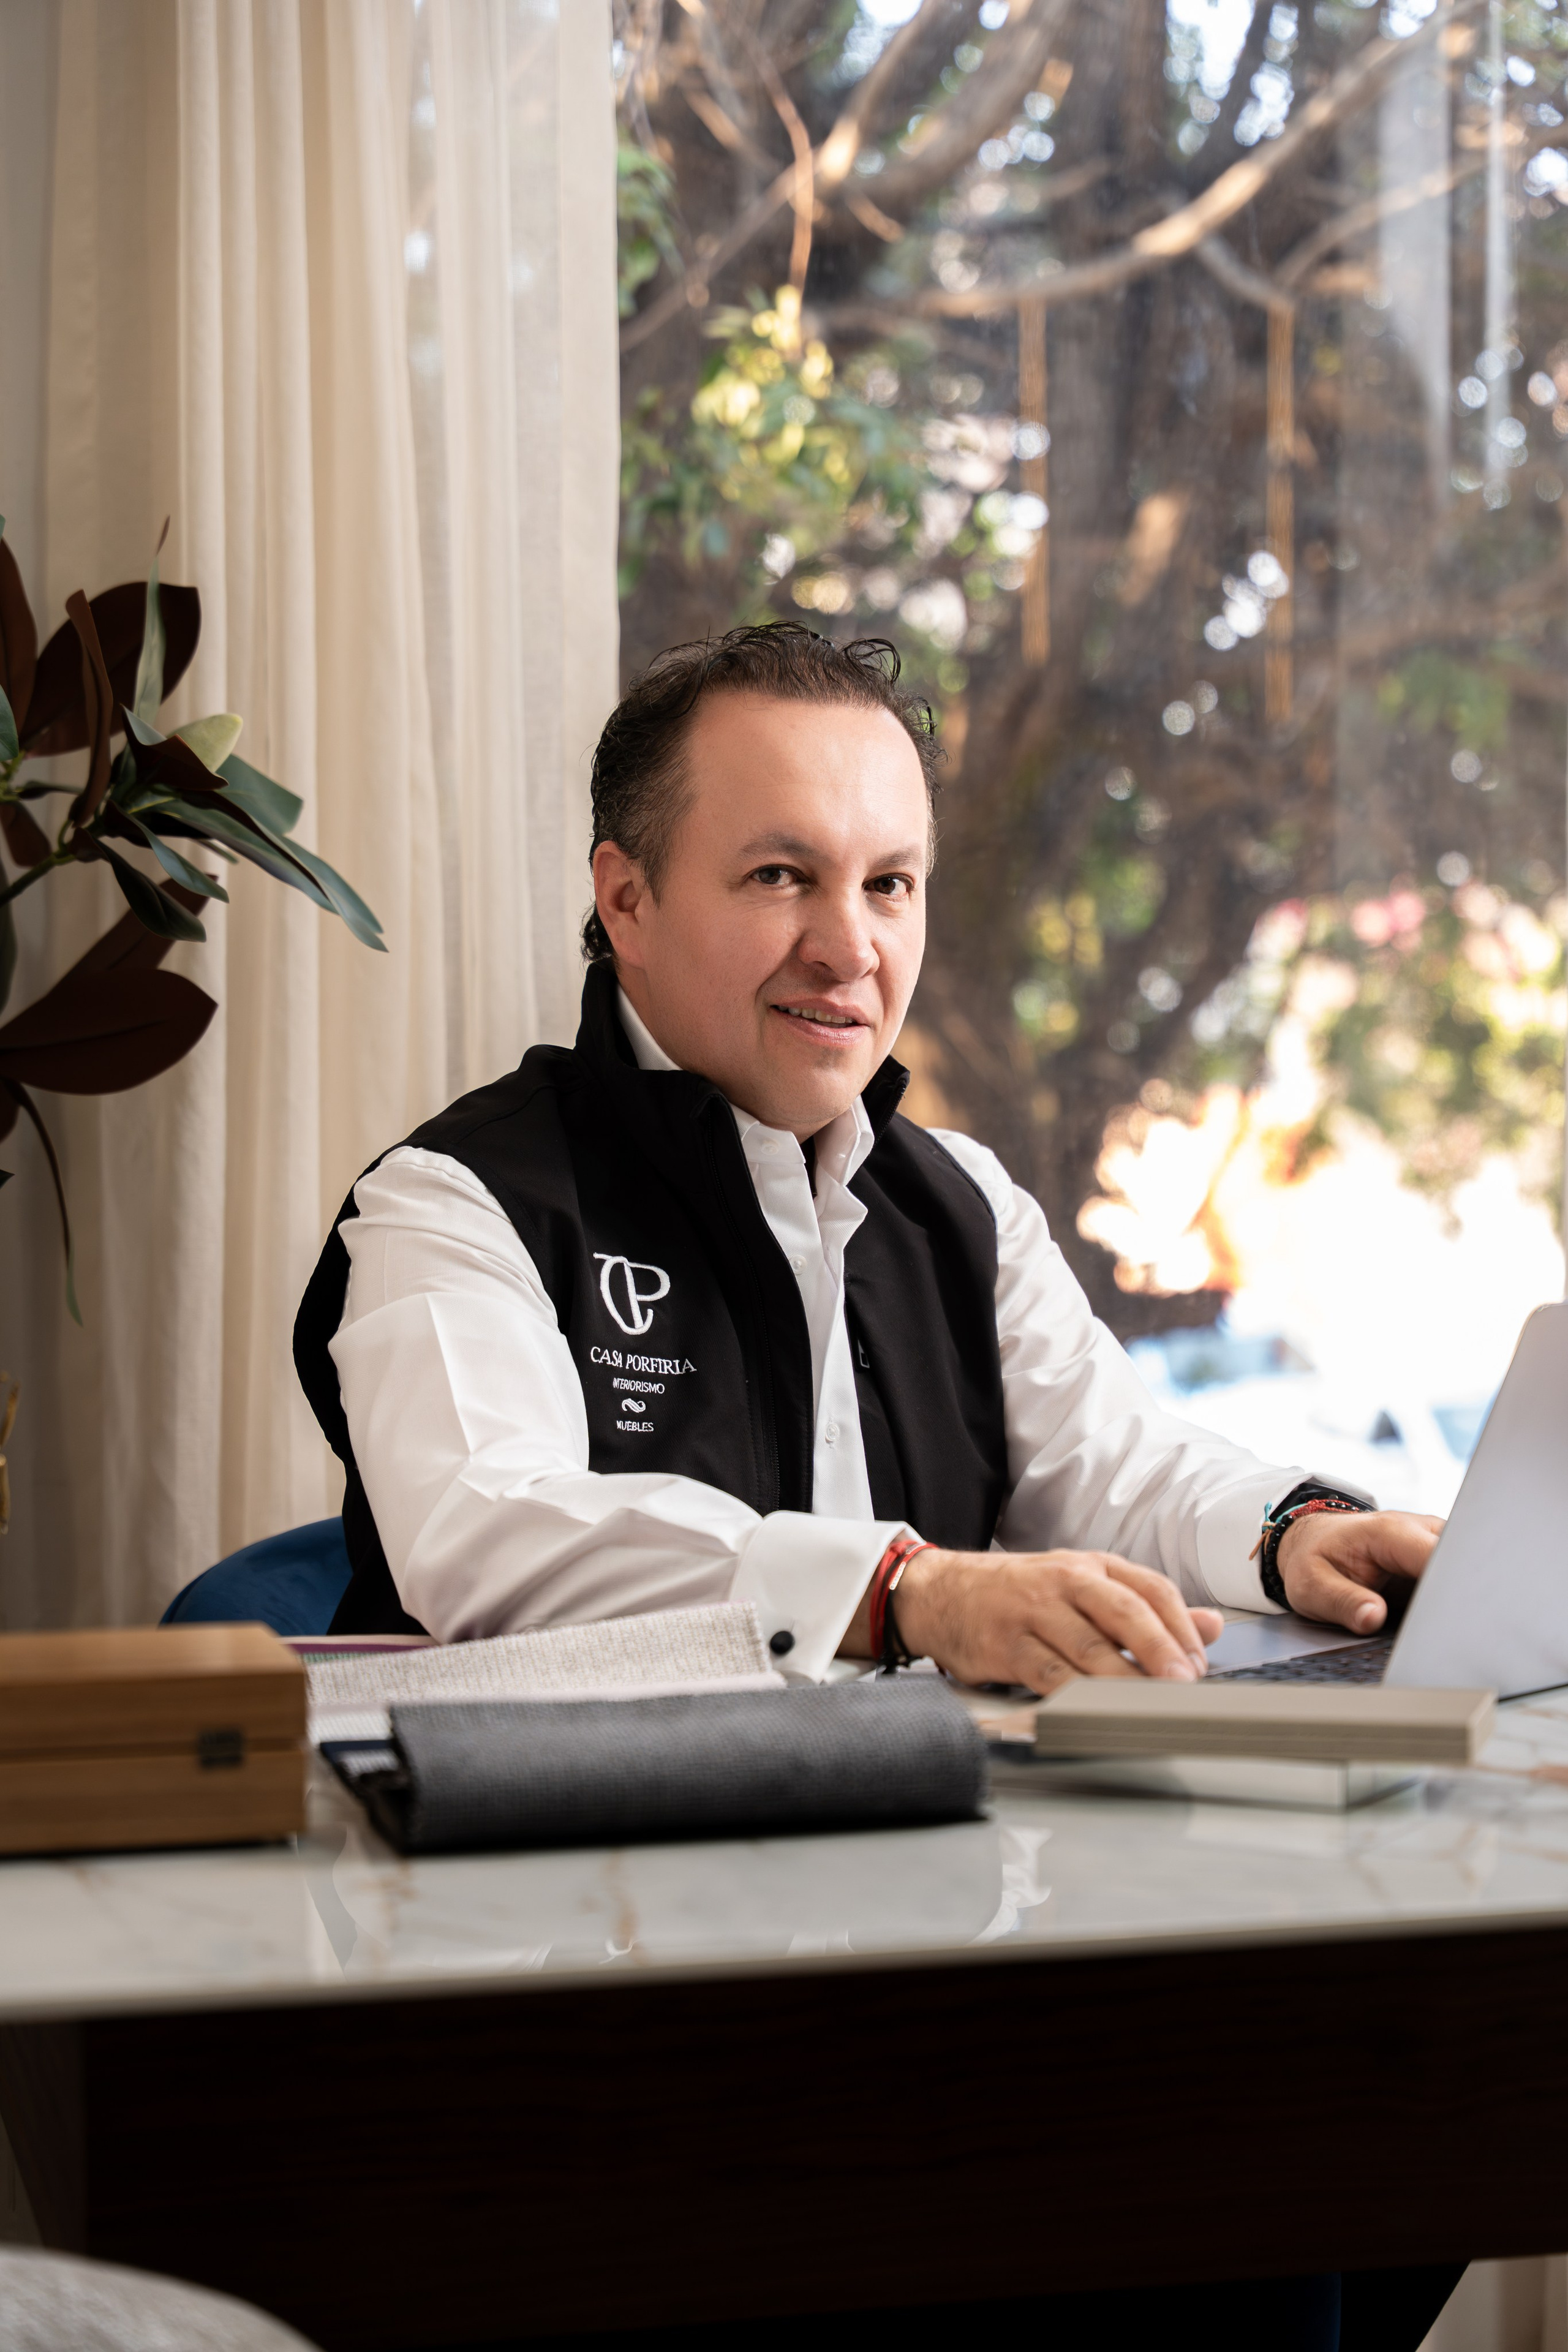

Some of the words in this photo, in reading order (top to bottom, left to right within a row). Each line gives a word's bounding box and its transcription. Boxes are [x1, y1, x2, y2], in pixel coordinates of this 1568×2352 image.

[590, 1346, 623, 1368] CASA
[625, 1354, 697, 1374] PORFIRIA
[612, 1378, 665, 1394] INTERIORISMO
[616, 1420, 654, 1432] MUEBLES
